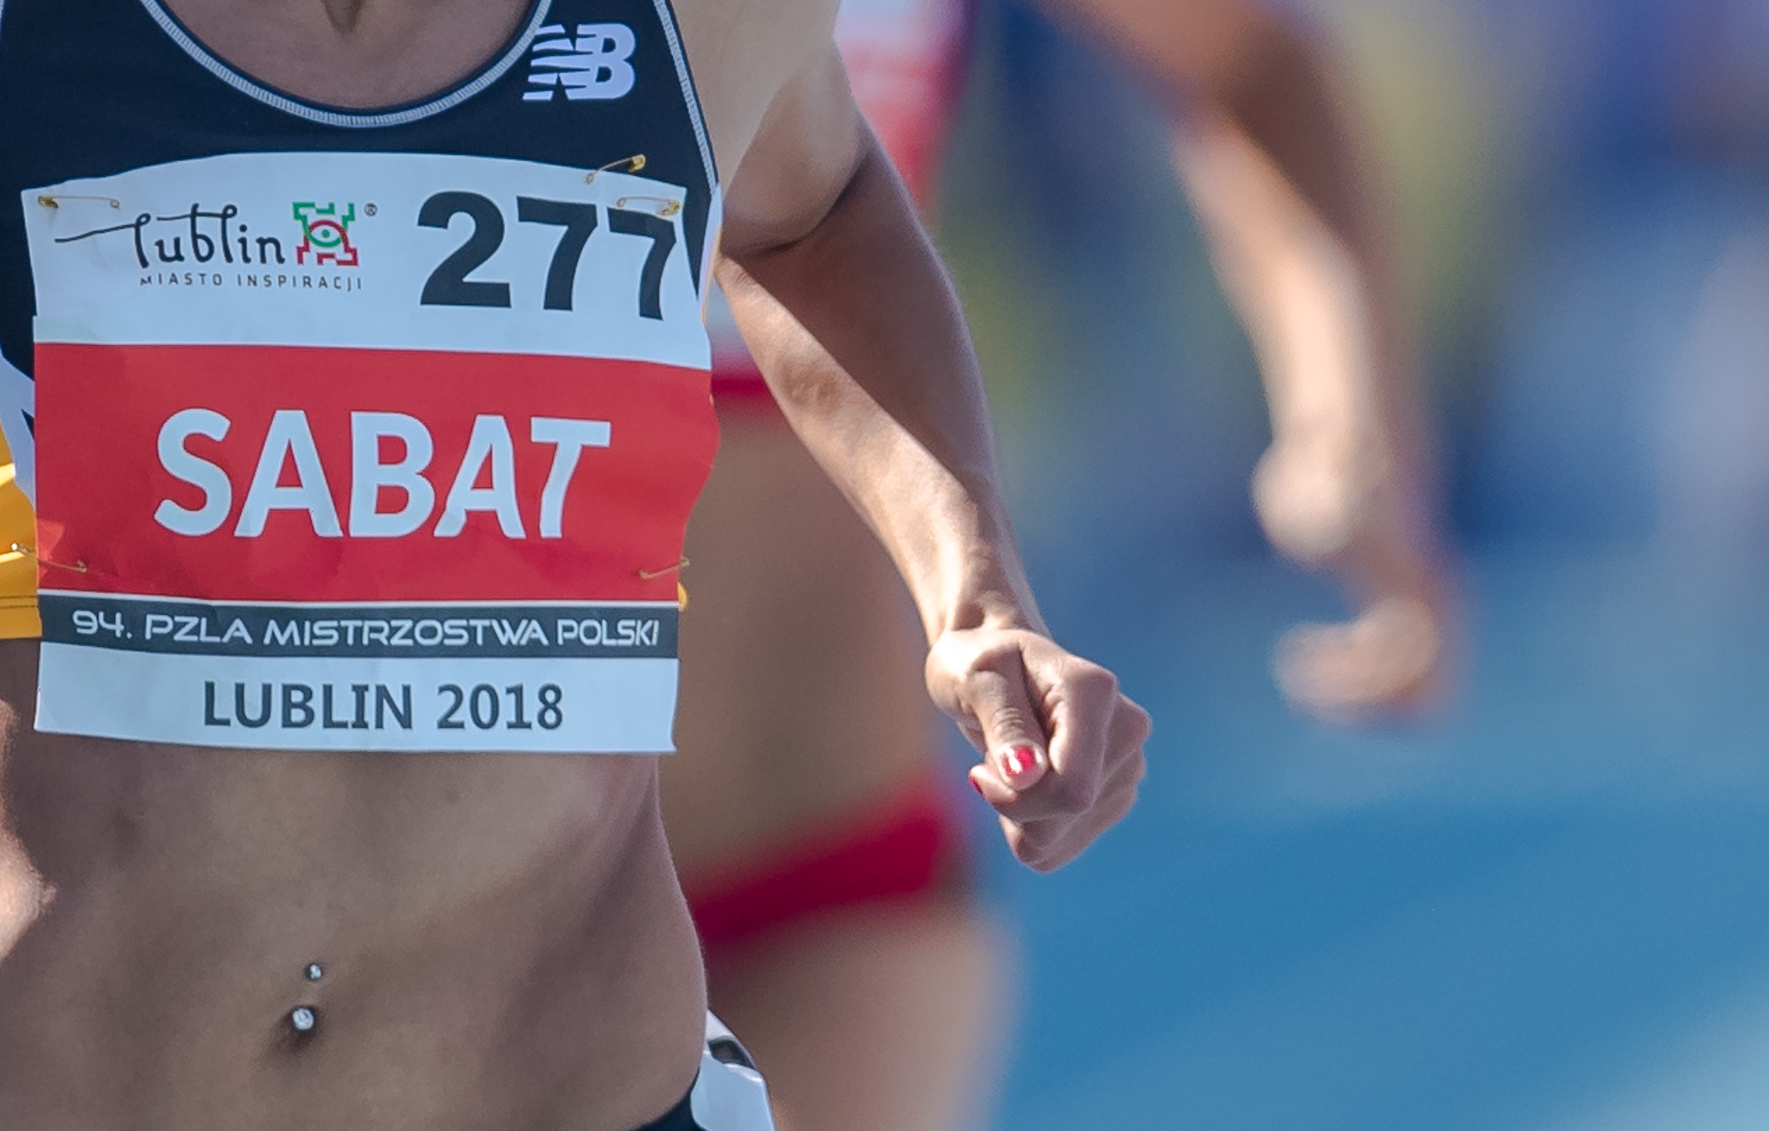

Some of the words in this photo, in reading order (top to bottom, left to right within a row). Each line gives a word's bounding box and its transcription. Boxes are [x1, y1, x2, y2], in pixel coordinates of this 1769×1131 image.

[416, 190, 677, 321] 277
[139, 271, 224, 287] MIASTO
[237, 273, 362, 293] INSPIRACJI
[153, 407, 611, 539] SABAT
[72, 610, 133, 641] 94.
[144, 614, 253, 645] PZLA
[263, 618, 548, 648] MISTRZOSTWA
[557, 619, 660, 647] POLSKI
[203, 681, 412, 730] LUBLIN
[436, 683, 564, 730] 2018
